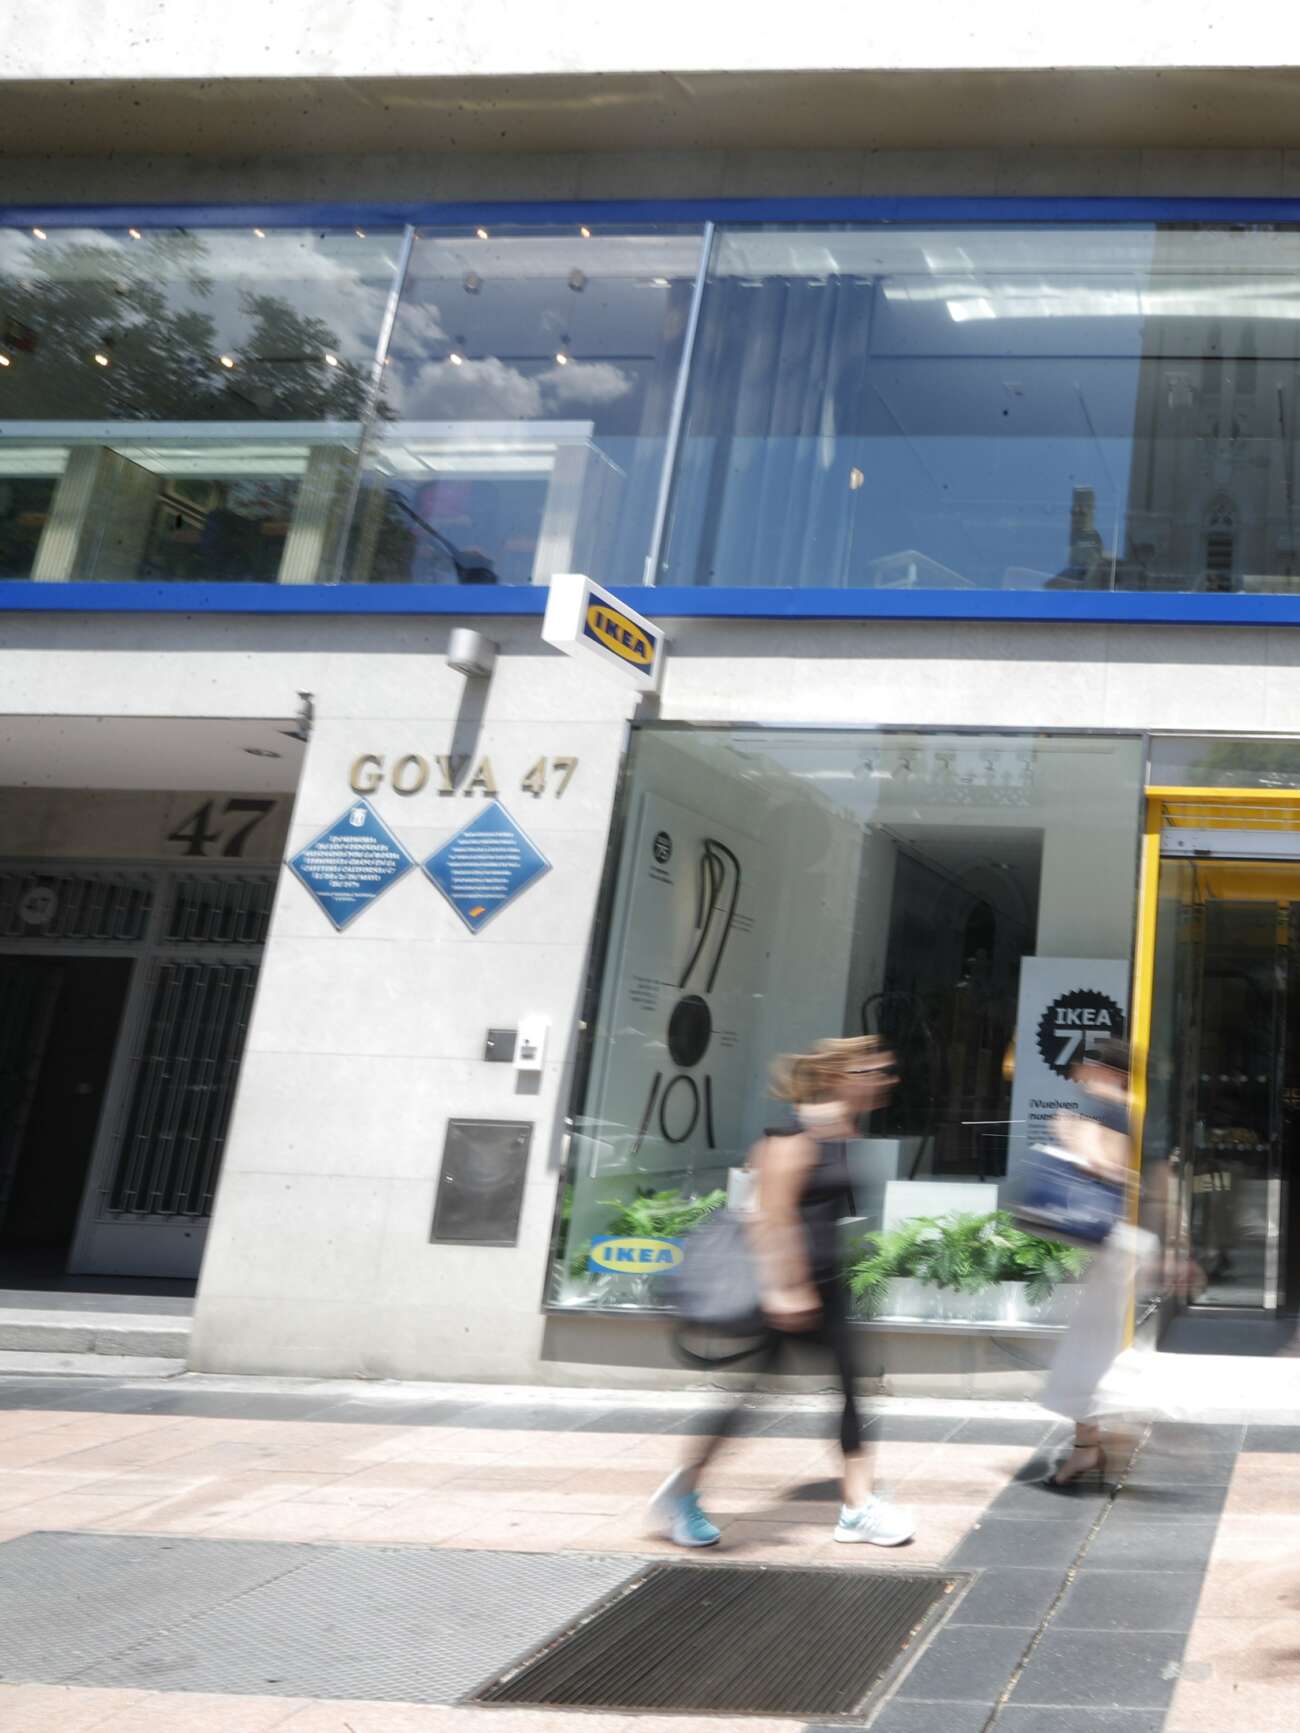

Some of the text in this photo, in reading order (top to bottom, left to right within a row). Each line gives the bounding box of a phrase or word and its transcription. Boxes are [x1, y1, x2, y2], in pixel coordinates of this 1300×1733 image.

[595, 611, 647, 659] IKEA
[348, 754, 580, 798] GOYA 47
[166, 798, 278, 858] 47
[1055, 1007, 1113, 1026] IKEA
[602, 1246, 674, 1263] IKEA
